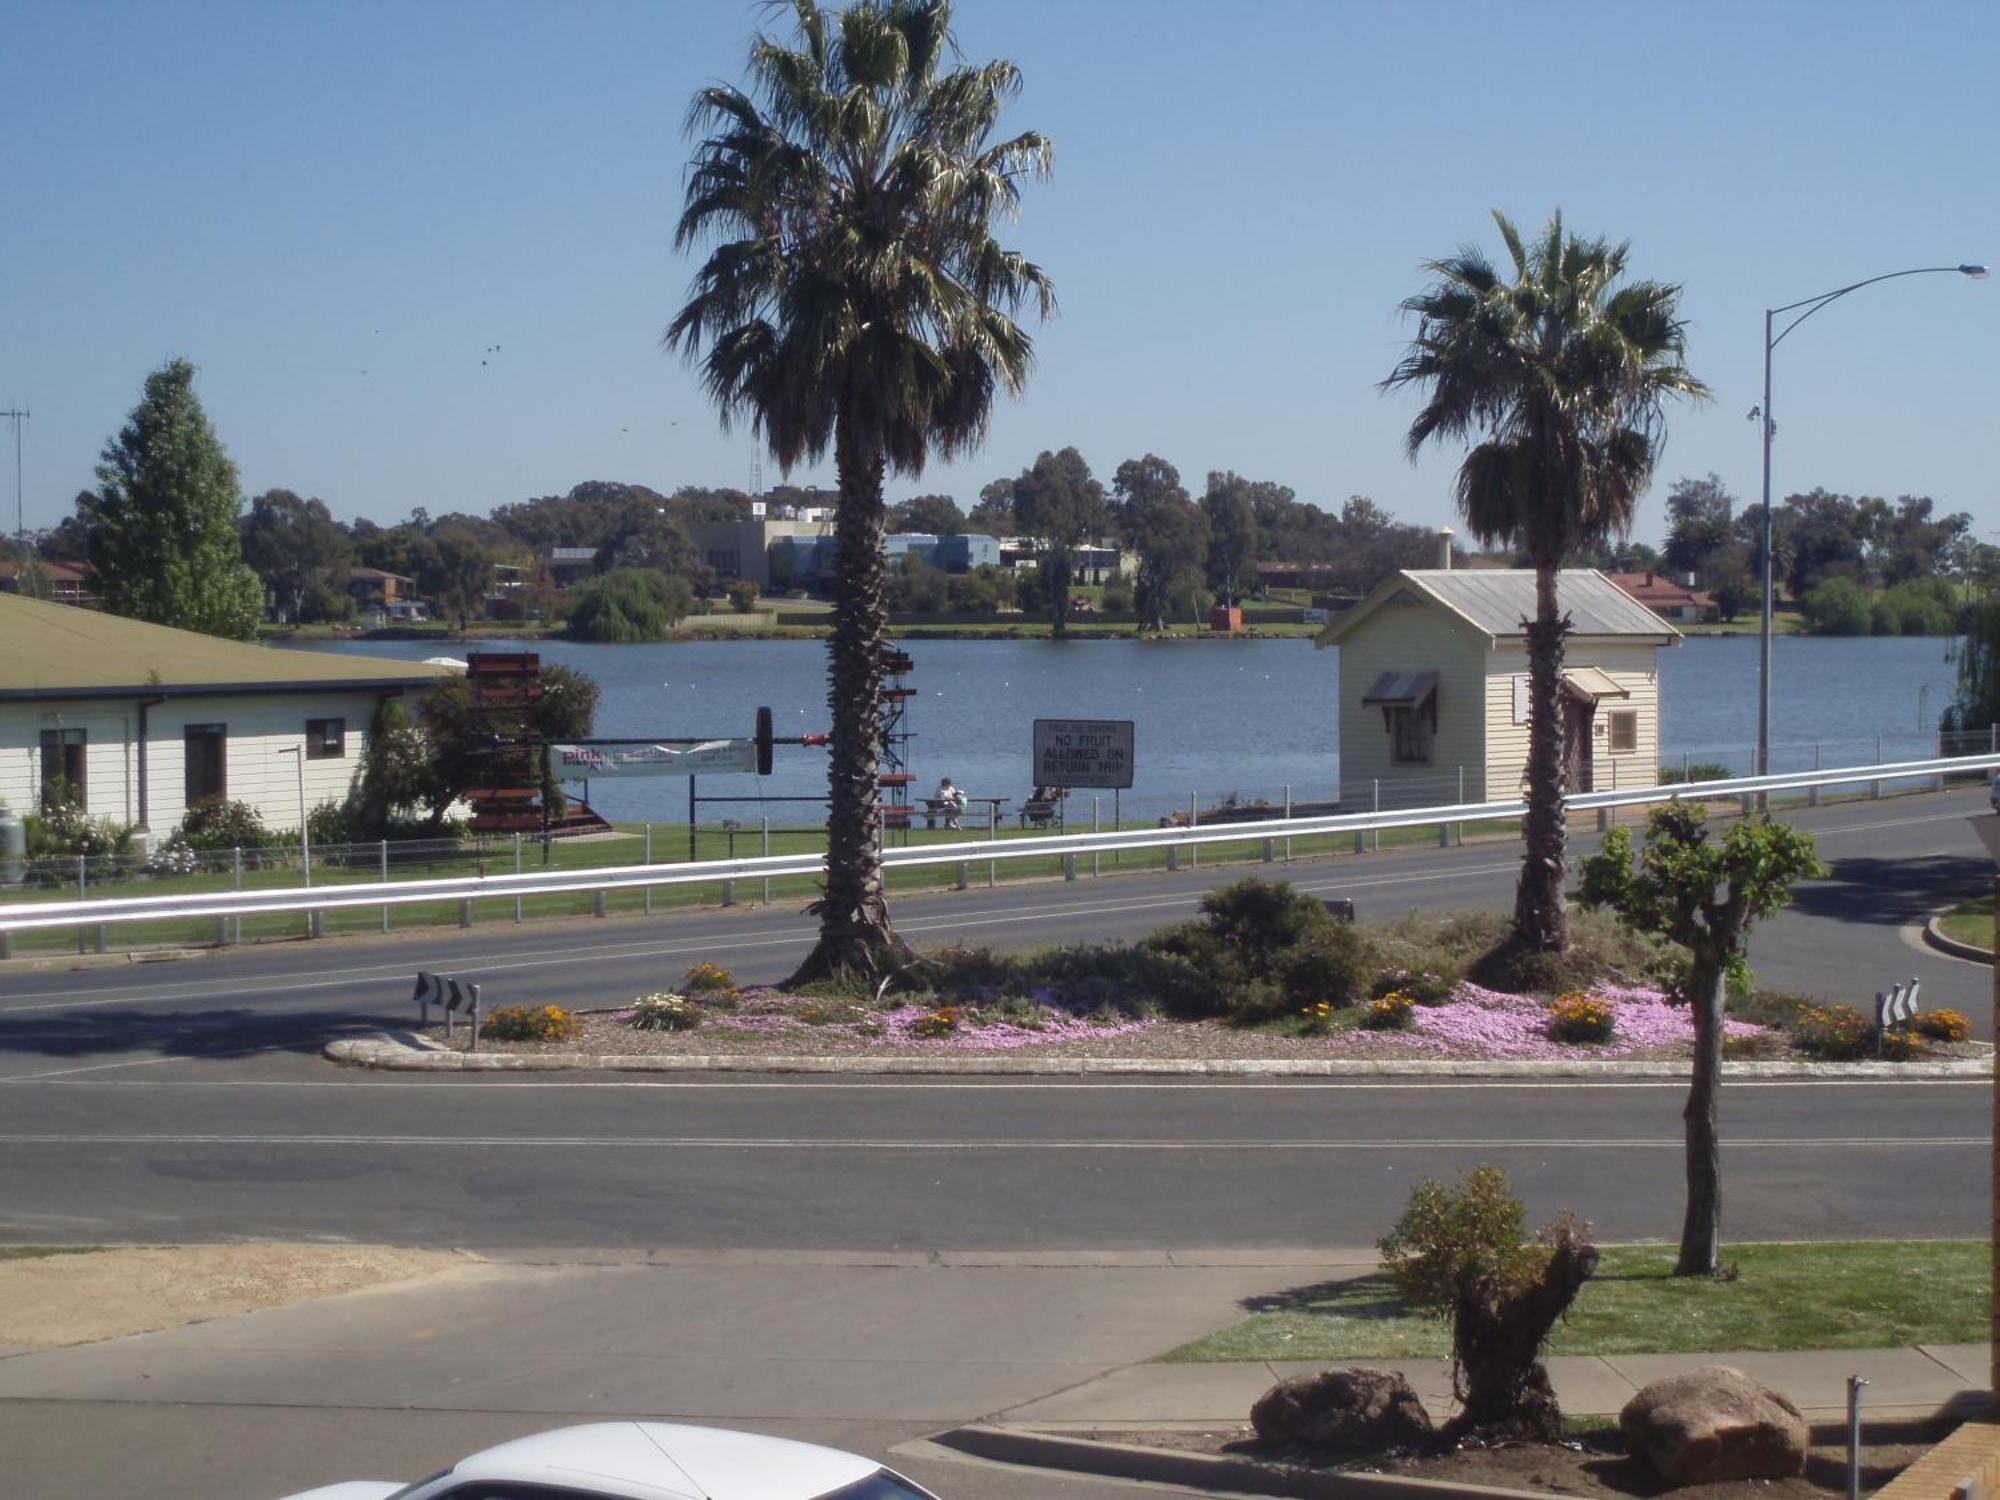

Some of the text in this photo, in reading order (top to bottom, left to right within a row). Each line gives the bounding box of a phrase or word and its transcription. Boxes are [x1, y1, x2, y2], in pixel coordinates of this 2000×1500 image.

[1055, 735, 1112, 747] NO FRUIT
[563, 748, 600, 765] pink
[1044, 748, 1124, 760] ALLOWED ON
[1043, 760, 1124, 774] RETURN TRIP
